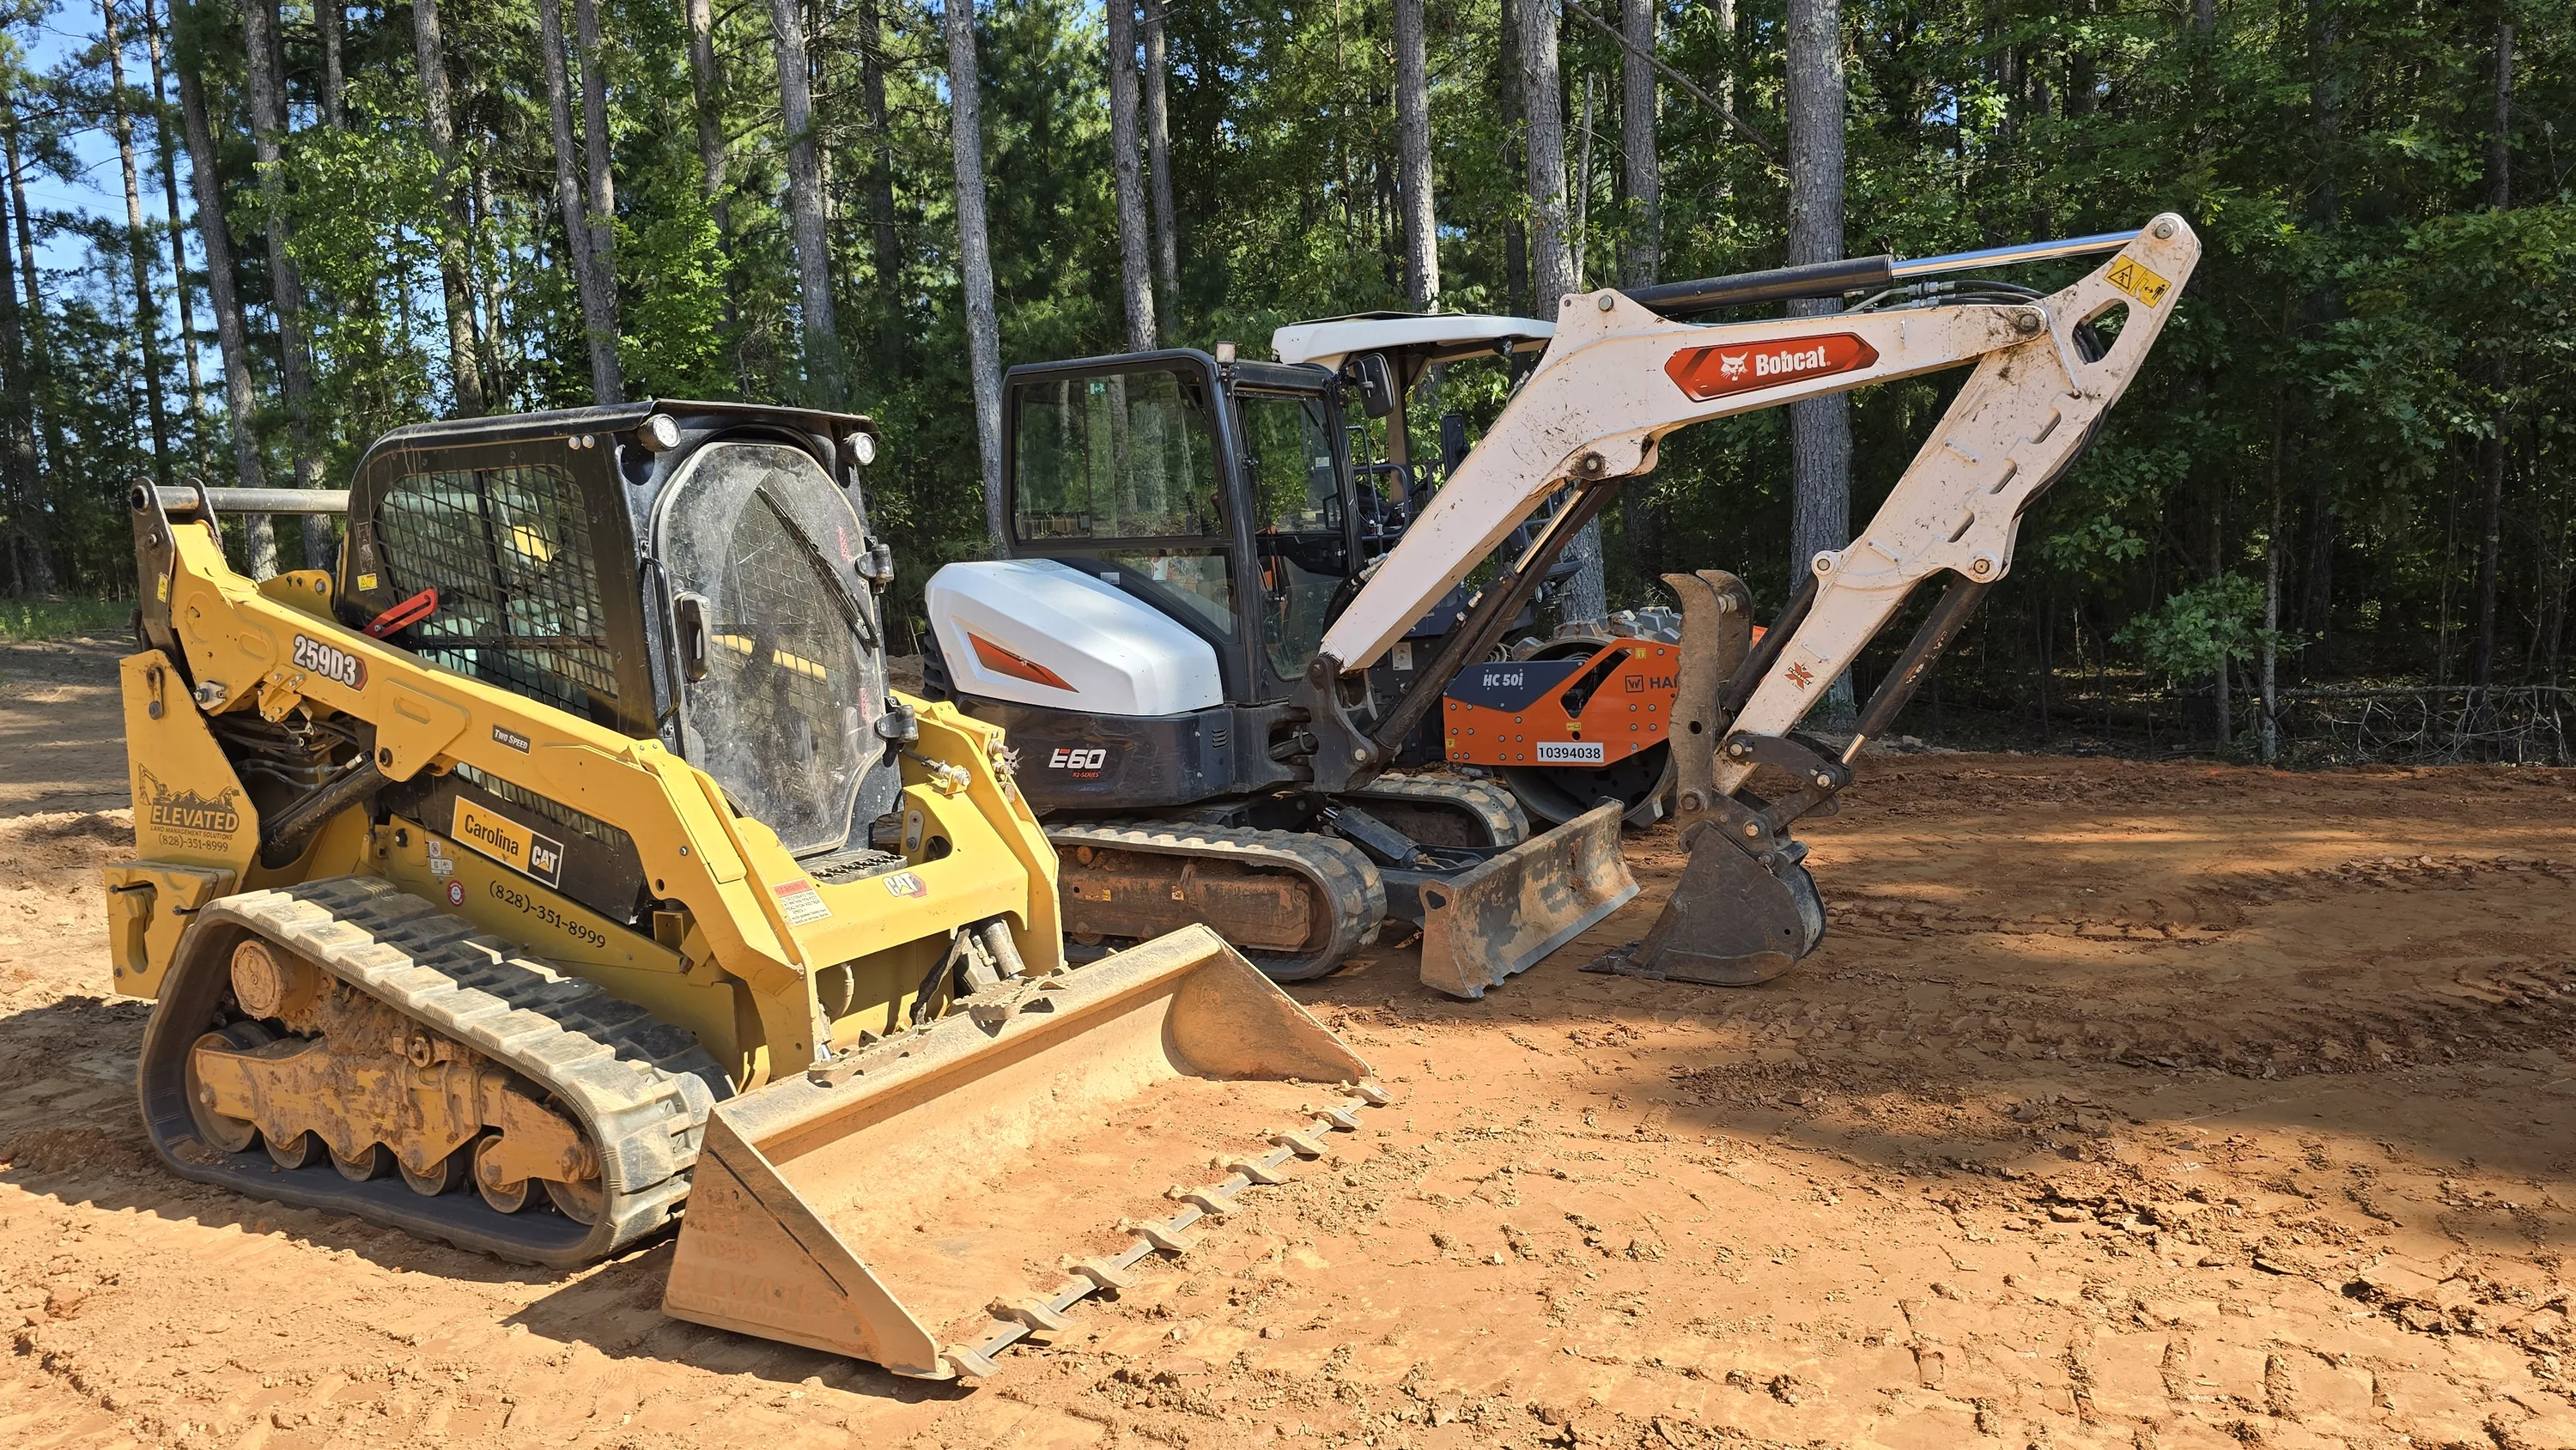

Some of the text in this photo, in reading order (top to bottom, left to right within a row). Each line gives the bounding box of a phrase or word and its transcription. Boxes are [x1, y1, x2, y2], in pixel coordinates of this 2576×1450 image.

[1755, 345, 1826, 377] Bobcat
[294, 635, 356, 686] 259D3
[1483, 673, 1524, 686] HC 50i
[1048, 749, 1107, 769] E60
[1539, 747, 1601, 760] 10394038
[152, 804, 238, 831] ELEVATED
[159, 833, 228, 852] (828)-351-8999
[165, 827, 203, 837] MANAGEMENT
[203, 831, 234, 840] SOLUTIONS
[465, 814, 519, 857] Carolina
[532, 846, 557, 874] CAT
[882, 871, 920, 897] CAT
[489, 880, 606, 949] (828)-351-8999
